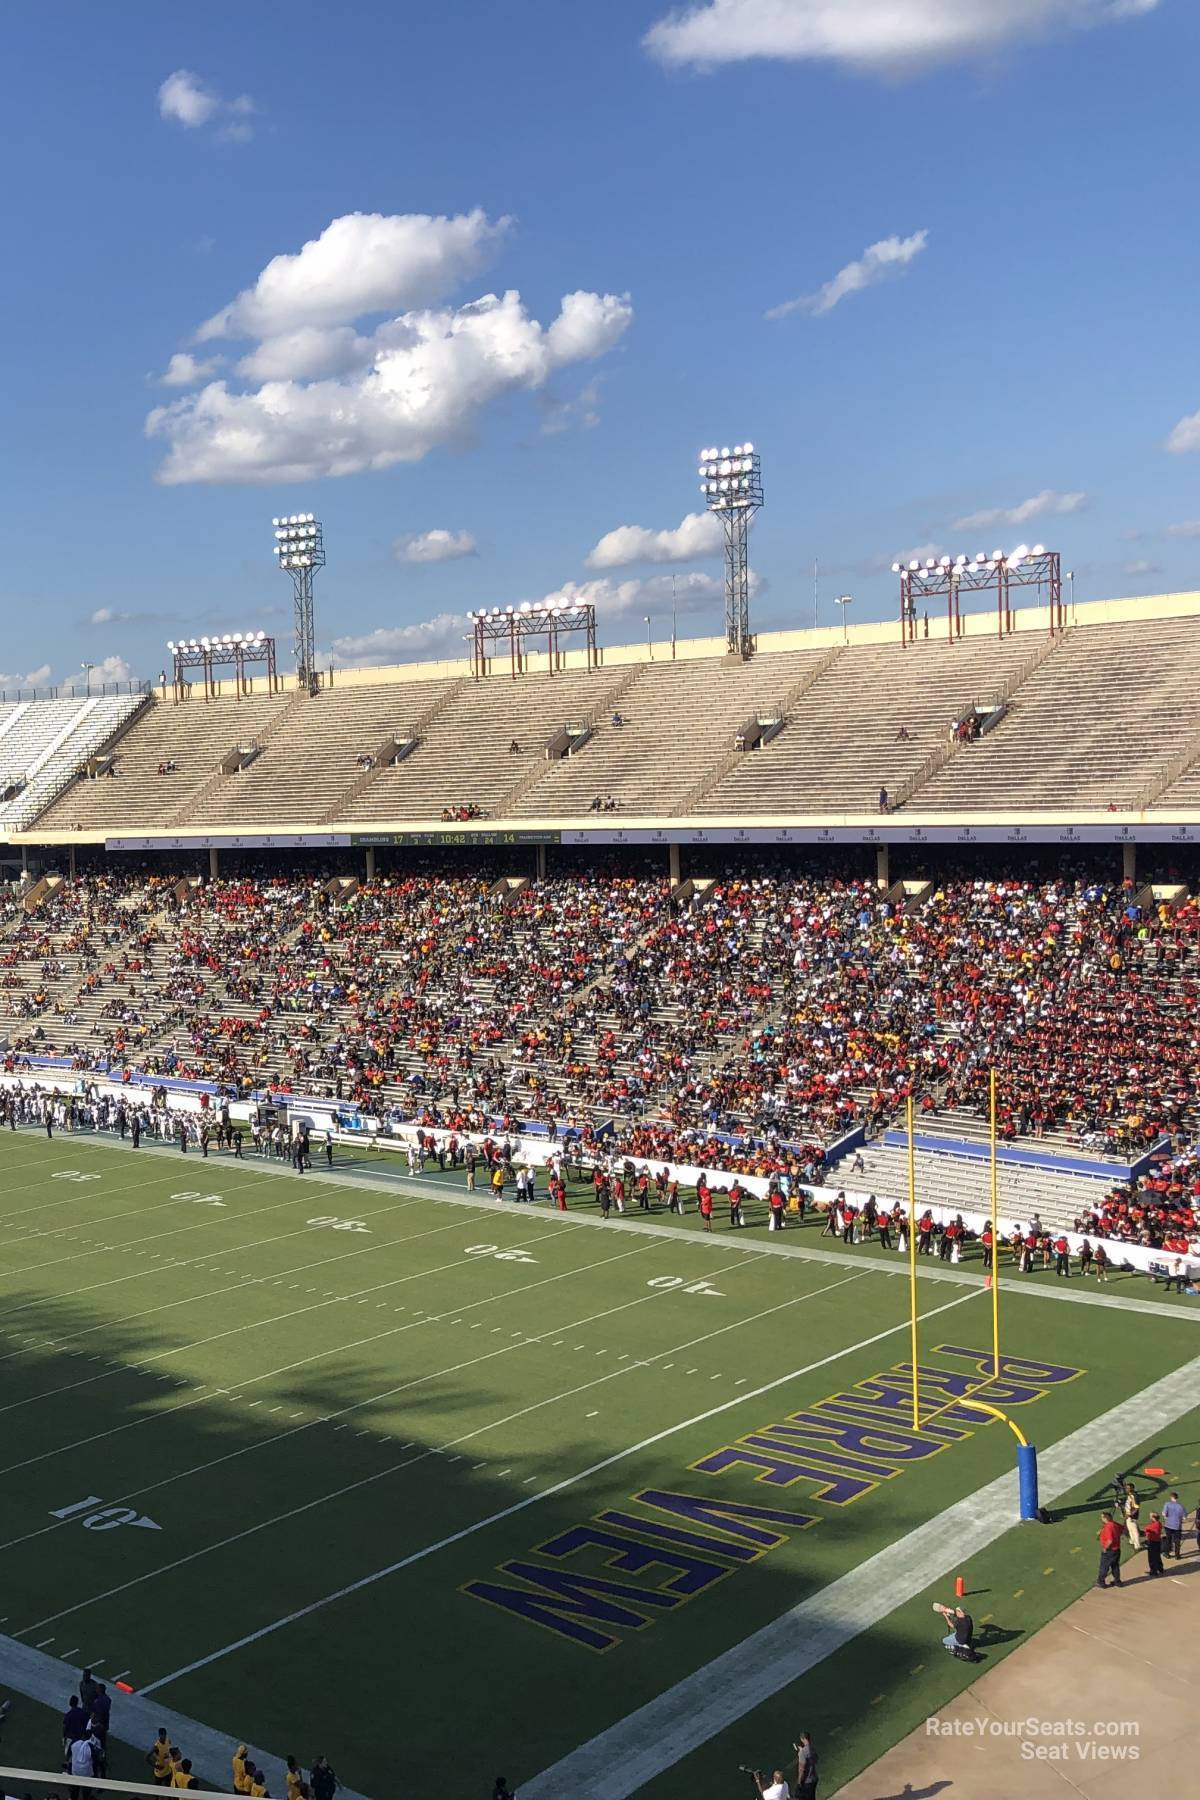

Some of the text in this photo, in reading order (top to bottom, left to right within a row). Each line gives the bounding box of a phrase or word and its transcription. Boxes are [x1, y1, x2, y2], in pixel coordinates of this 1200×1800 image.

[393, 836, 404, 845] 17
[440, 834, 466, 844] 10:42
[503, 833, 515, 843] 14
[51, 1170, 102, 1182] 50
[306, 1215, 361, 1233] 30
[464, 1243, 530, 1261] 20
[647, 1275, 711, 1295] 10
[458, 1344, 1087, 1656] PRAIRIE VIEW
[49, 1496, 138, 1531] 10
